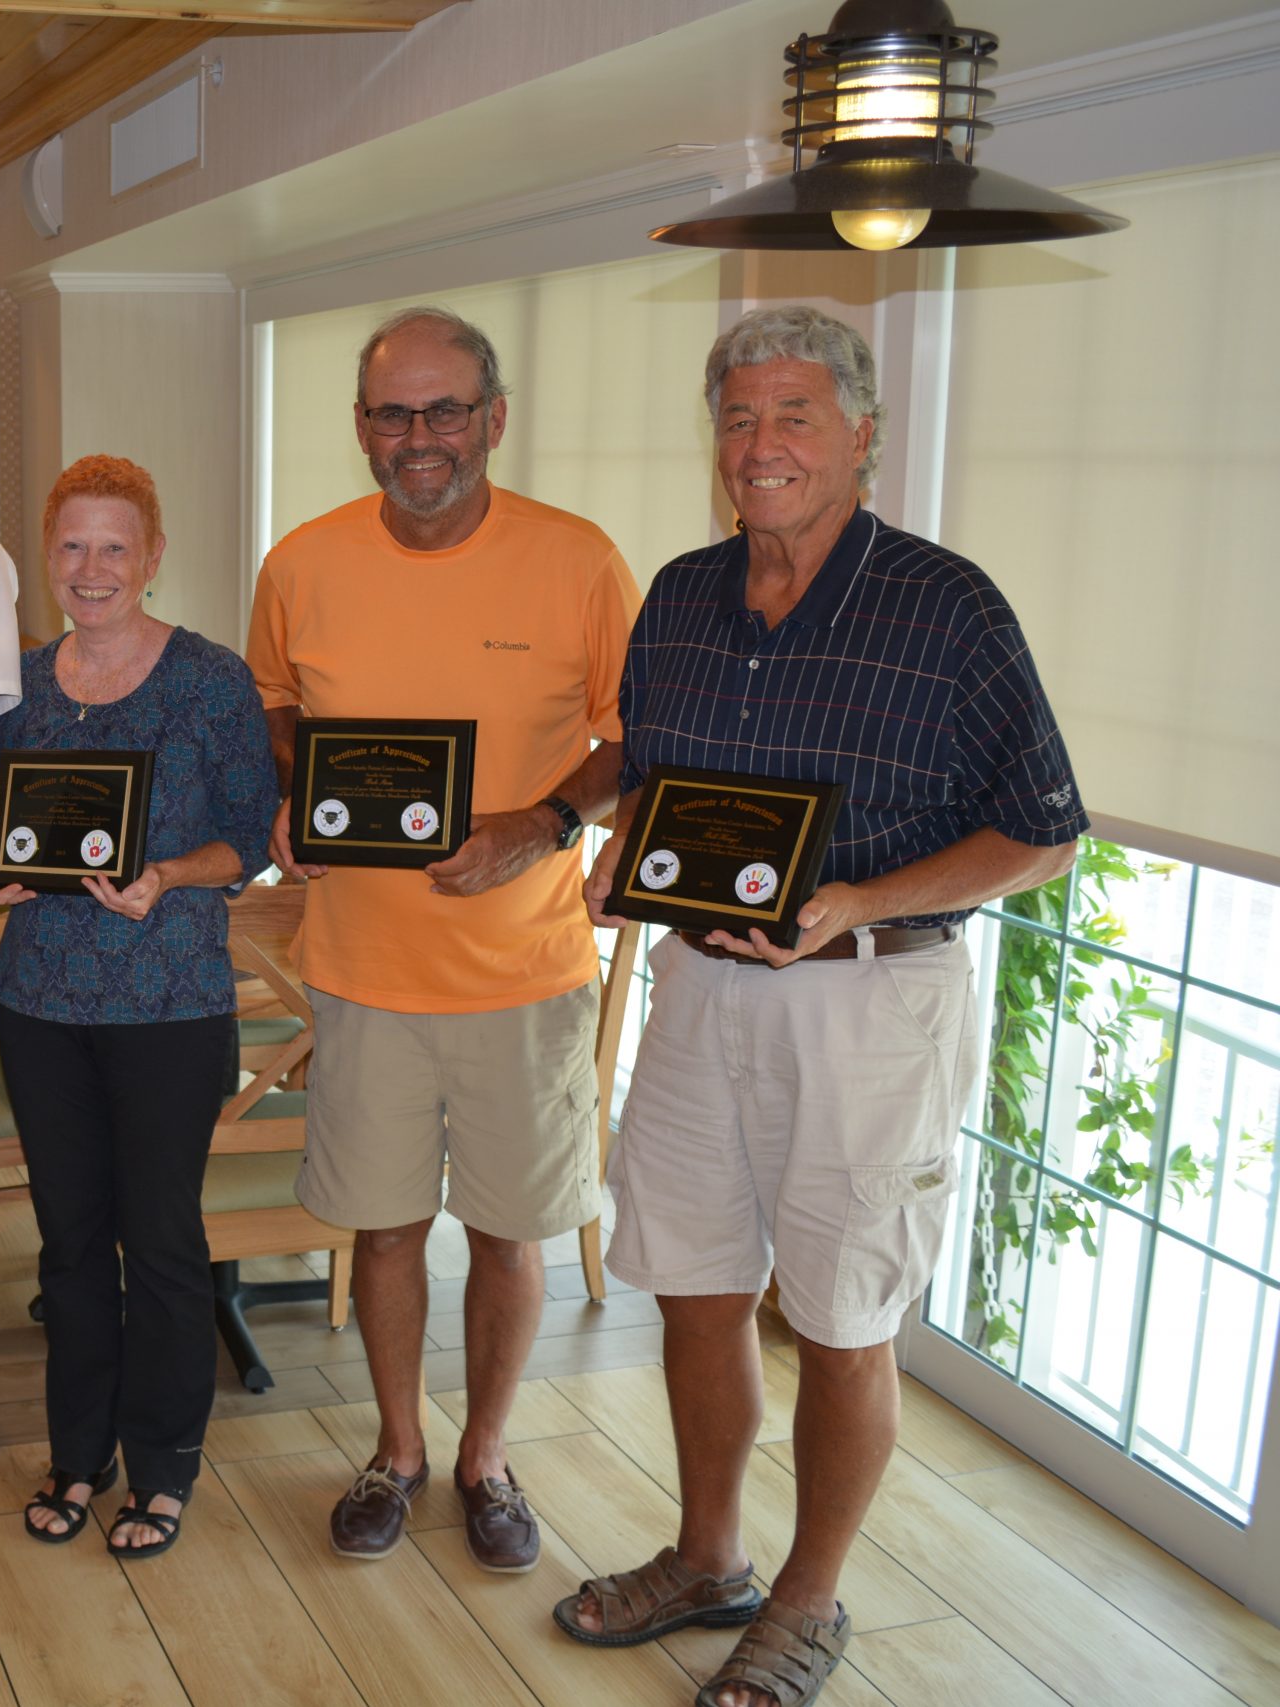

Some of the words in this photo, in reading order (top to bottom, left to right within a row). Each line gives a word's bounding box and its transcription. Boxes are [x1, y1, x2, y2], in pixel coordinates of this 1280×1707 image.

[492, 641, 530, 651] Columbia
[328, 747, 367, 764] Certificate
[371, 746, 378, 754] of
[383, 745, 431, 767] Appreciation
[672, 799, 717, 814] Certificate
[720, 798, 731, 808] of
[734, 798, 784, 826] Appreciation
